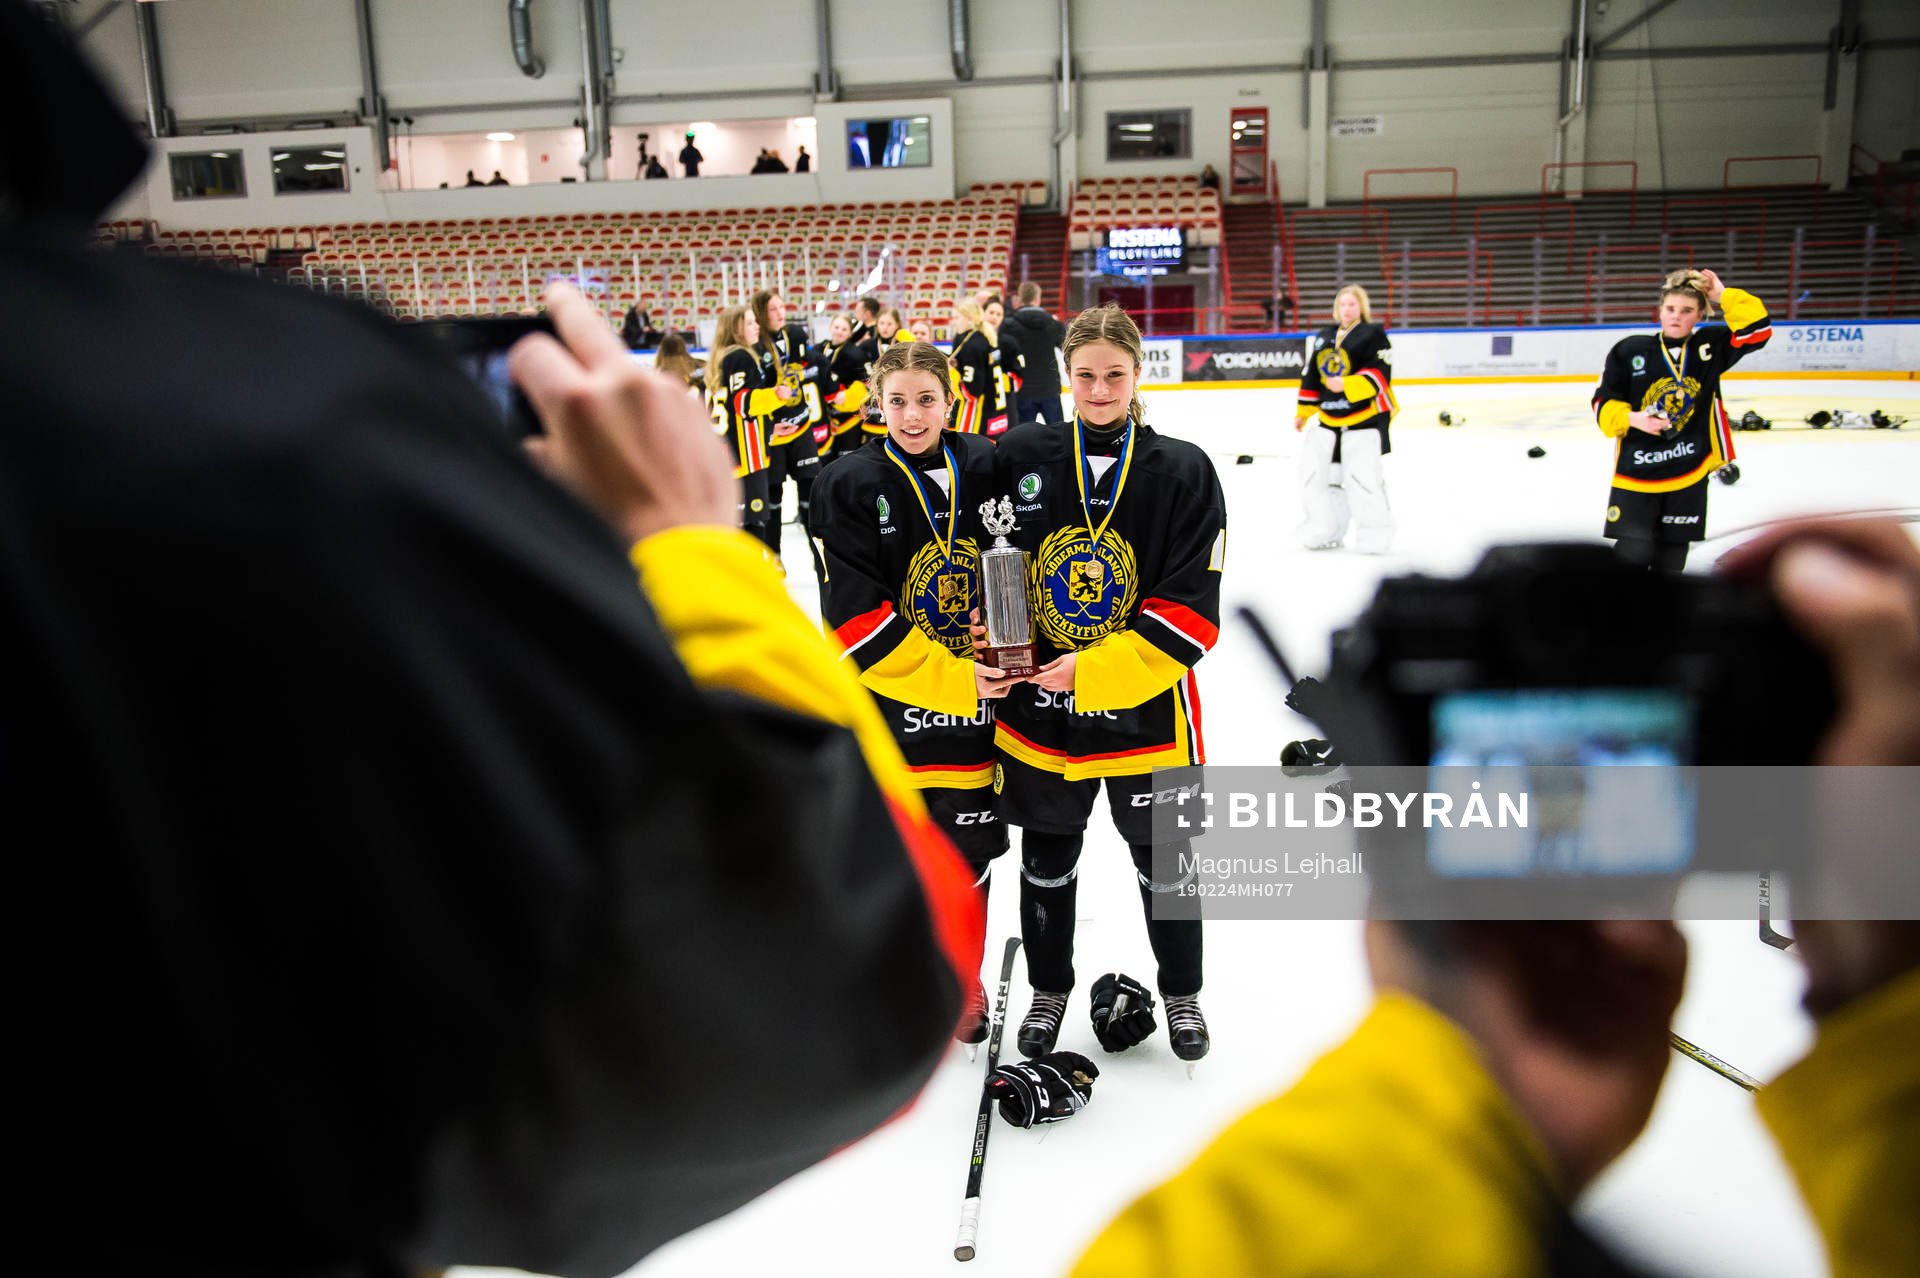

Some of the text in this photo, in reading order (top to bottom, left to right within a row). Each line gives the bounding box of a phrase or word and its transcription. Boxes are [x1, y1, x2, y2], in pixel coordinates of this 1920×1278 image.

[1806, 327, 1864, 341] STENA
[1213, 352, 1304, 369] YOKOHAMA
[1698, 343, 1712, 361] C
[963, 365, 975, 382] 3
[1148, 366, 1170, 378] AB
[729, 371, 746, 392] 15
[1633, 442, 1695, 464] Scandic
[1015, 503, 1042, 512] ŠKODA
[1045, 543, 1125, 585] SÖDERMALANDS
[955, 810, 998, 825] CC
[993, 980, 1009, 1026] CCM
